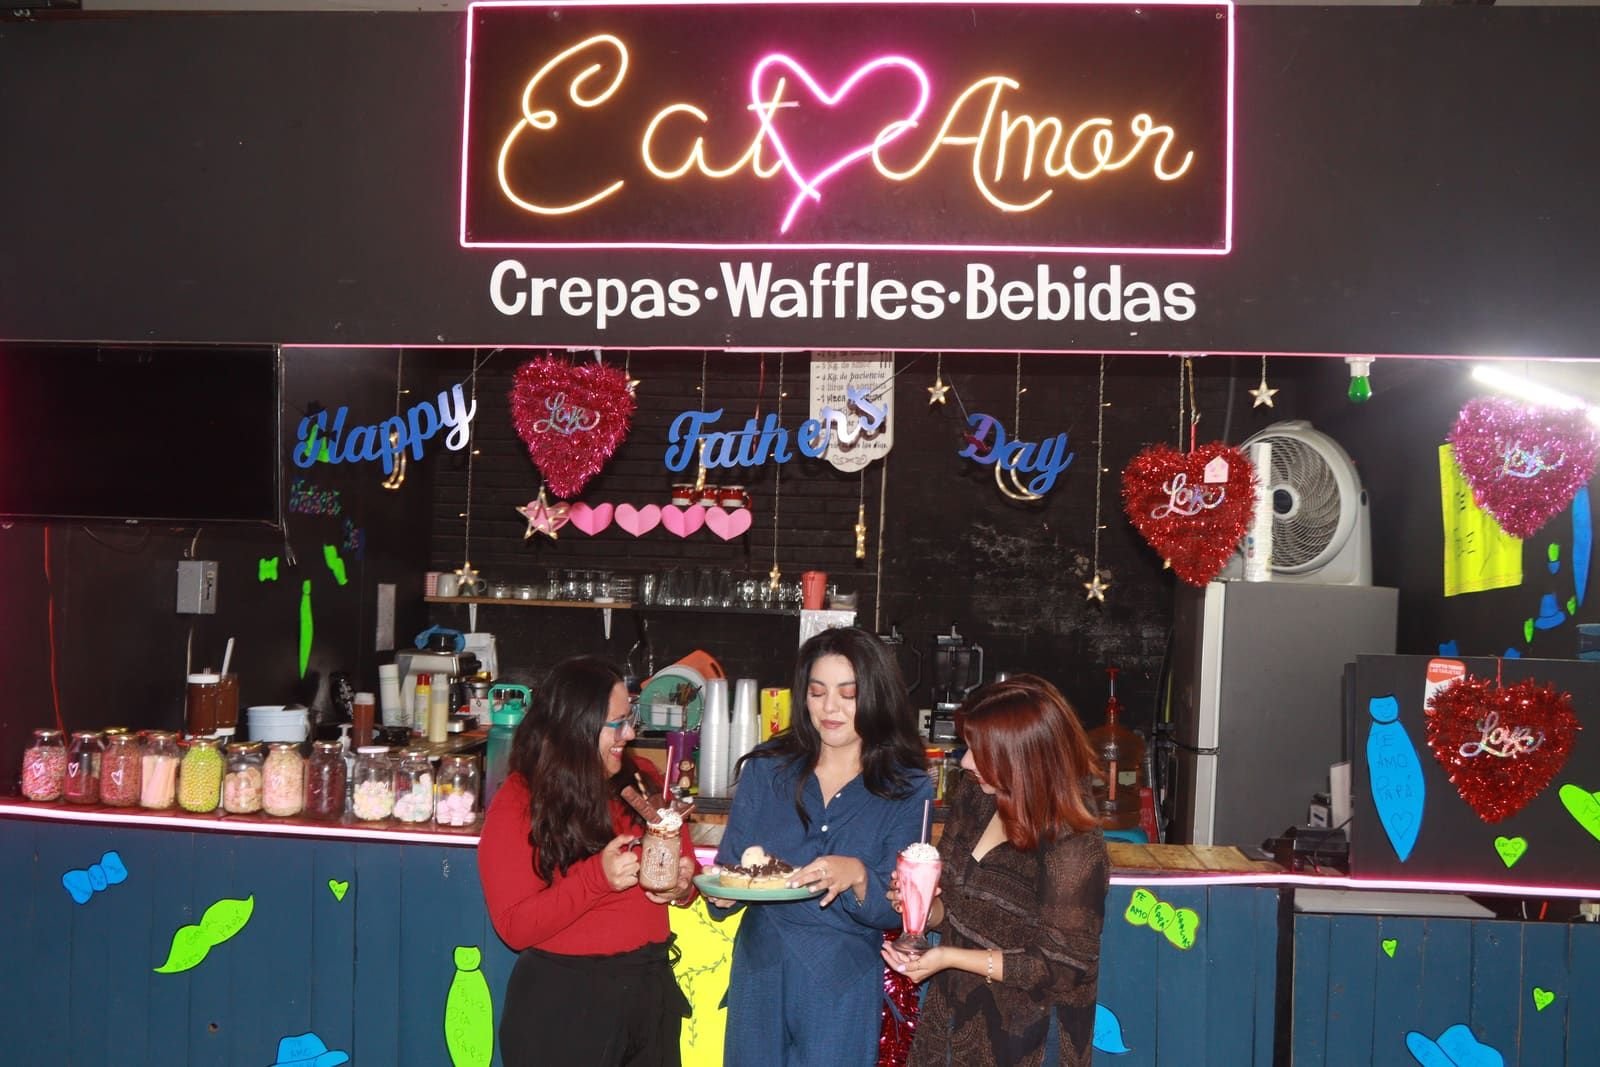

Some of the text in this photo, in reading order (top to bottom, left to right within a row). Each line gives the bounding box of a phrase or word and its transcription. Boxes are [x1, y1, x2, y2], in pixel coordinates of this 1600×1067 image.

[497, 35, 1195, 215] Eat Amor
[489, 258, 1197, 330] Crepas Waffles Bebidas
[292, 383, 477, 475] Happy
[958, 412, 1075, 495] Day
[1459, 710, 1545, 758] Love
[1130, 905, 1147, 919] AMO
[1136, 892, 1146, 901] TE
